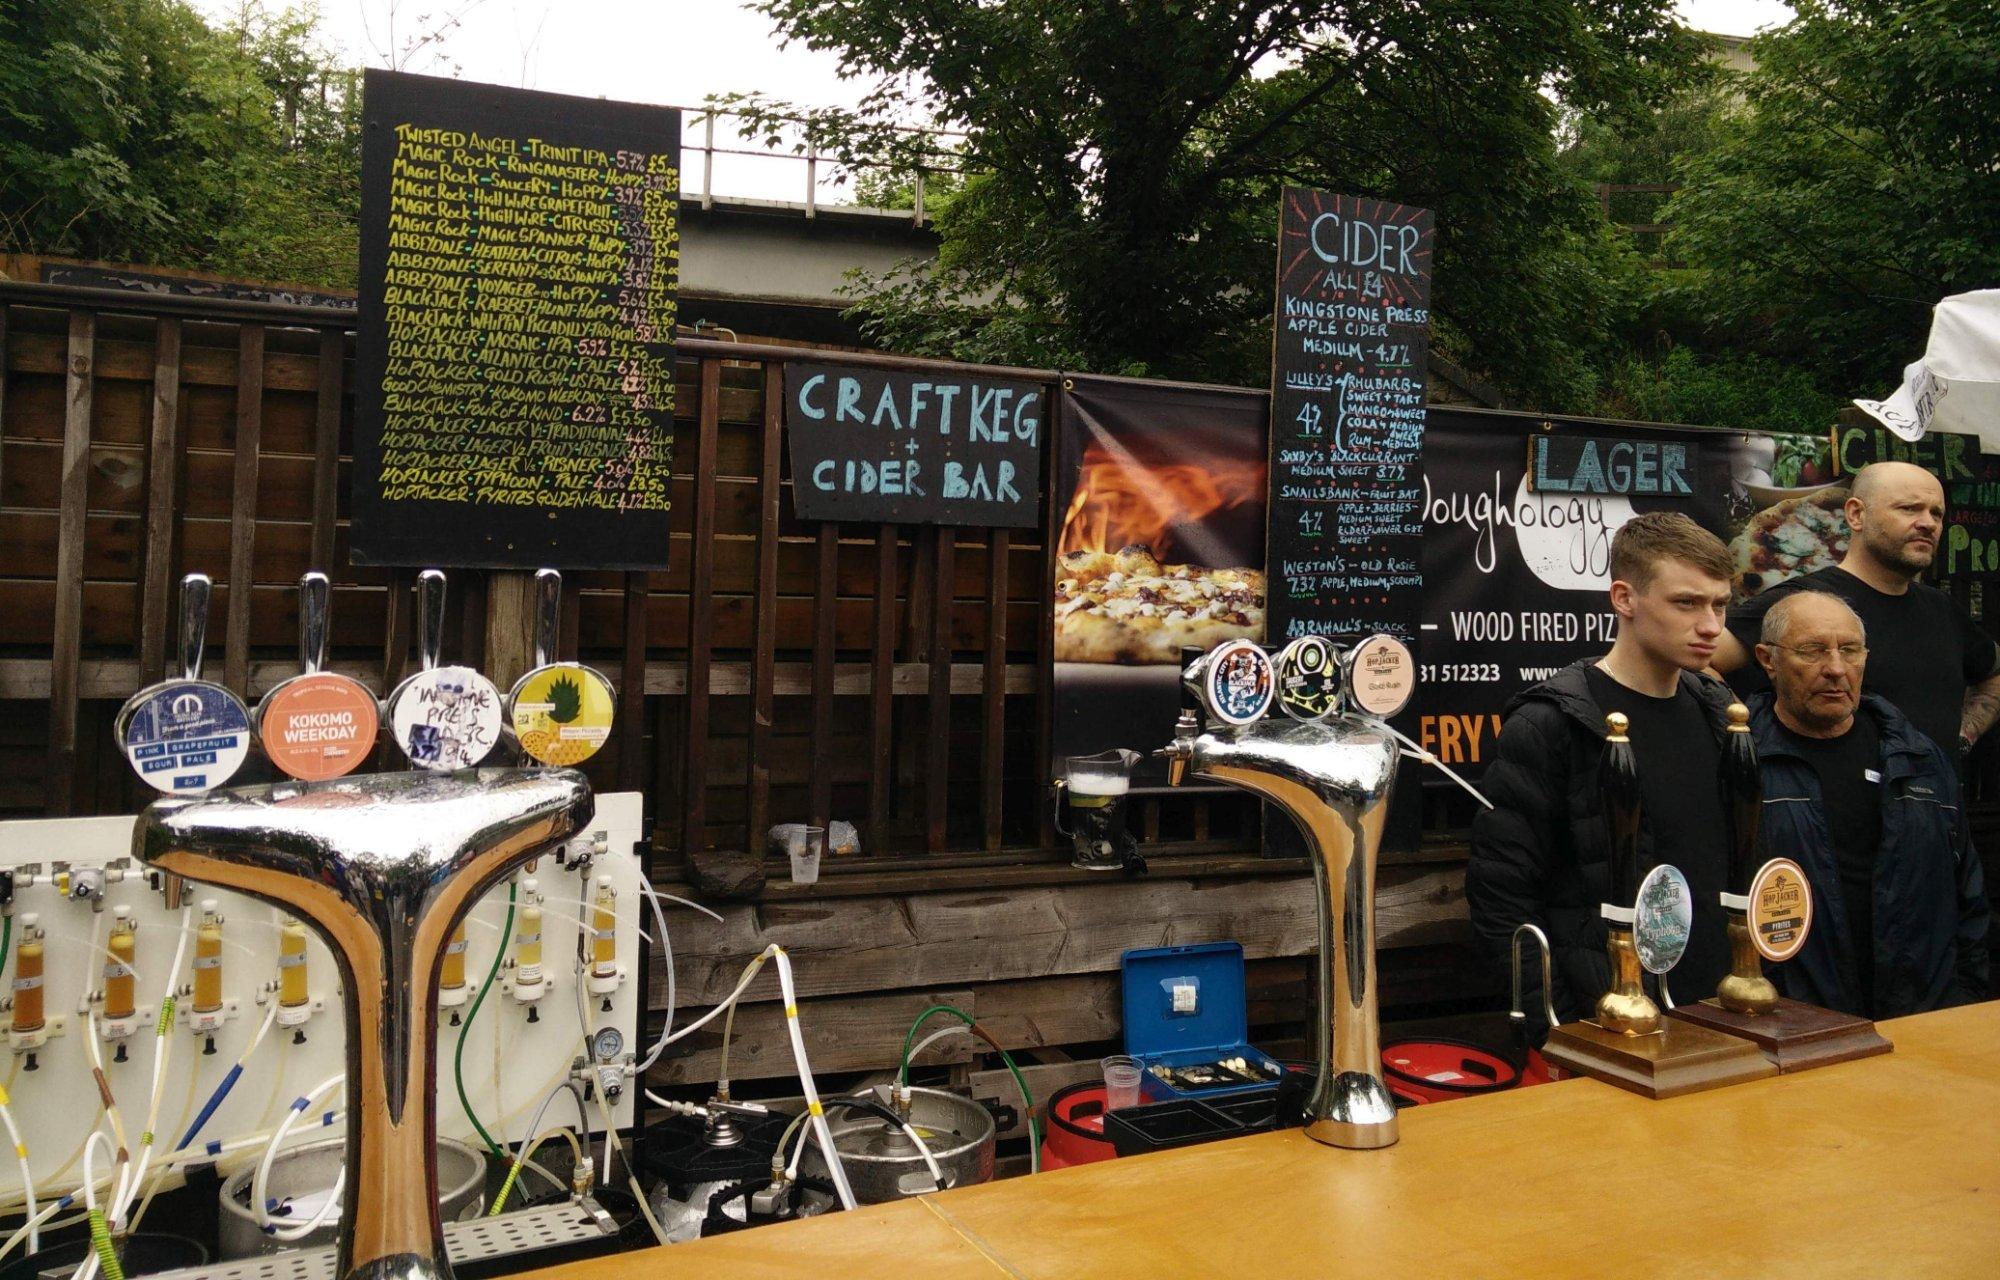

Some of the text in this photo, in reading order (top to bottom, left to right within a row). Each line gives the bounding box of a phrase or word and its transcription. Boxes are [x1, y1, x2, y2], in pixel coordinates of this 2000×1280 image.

[395, 124, 466, 147] TWISTED
[468, 132, 521, 156] ANGEL
[583, 150, 608, 168] IPA
[392, 158, 438, 180] MAGIC
[440, 164, 479, 185] ROCK
[398, 142, 446, 162] MAGIC
[452, 148, 499, 170] ROCK
[508, 156, 599, 182] RINGMASTER
[391, 177, 436, 198] MAGIC
[474, 188, 502, 206] HIGH
[539, 196, 610, 218] GRAPEFRUIT
[391, 196, 437, 216] MAGIC
[479, 206, 513, 224] HIGH
[388, 214, 434, 232] MAGIC
[478, 225, 518, 242] MAGIC
[389, 231, 467, 254] ABBEYDALE
[471, 242, 530, 261] HEATHEN
[536, 248, 583, 266] CITRUS
[1311, 212, 1420, 276] CIDER
[386, 251, 474, 272] ABBEYDALE
[384, 268, 473, 292] ABBEYDALE
[1323, 269, 1358, 290] ALL
[1286, 294, 1428, 324] KINGSTONE PRESS
[1288, 318, 1389, 338] APPLE CIDER
[486, 331, 540, 350] MOSAIC
[547, 336, 572, 354] IPA
[1304, 338, 1364, 362] MEDIUM
[484, 366, 523, 384] GOLD
[1348, 375, 1410, 393] RHUBARB
[1346, 390, 1421, 405] SWEET TART
[529, 404, 562, 420] KIND
[799, 374, 1038, 448] CRAFT KEG
[1347, 404, 1387, 418] MANGO
[476, 420, 530, 436] LAGER
[1347, 418, 1378, 429] COLA
[1537, 437, 1693, 494] LAGER
[555, 474, 592, 489] PALE
[812, 460, 1022, 503] CIDER BAR
[536, 490, 587, 508] GOLDEN
[1280, 485, 1360, 500] SNAILSBANK
[1397, 489, 1420, 499] BAT
[1361, 560, 1382, 572] OLD
[1451, 611, 1514, 642] WOOD
[1521, 612, 1579, 642] FIRED
[1441, 663, 1500, 682] 512323
[289, 711, 353, 729] KOKOMO
[284, 725, 358, 744] WEEKDAY
[172, 739, 231, 752] GRAPEFRUIT
